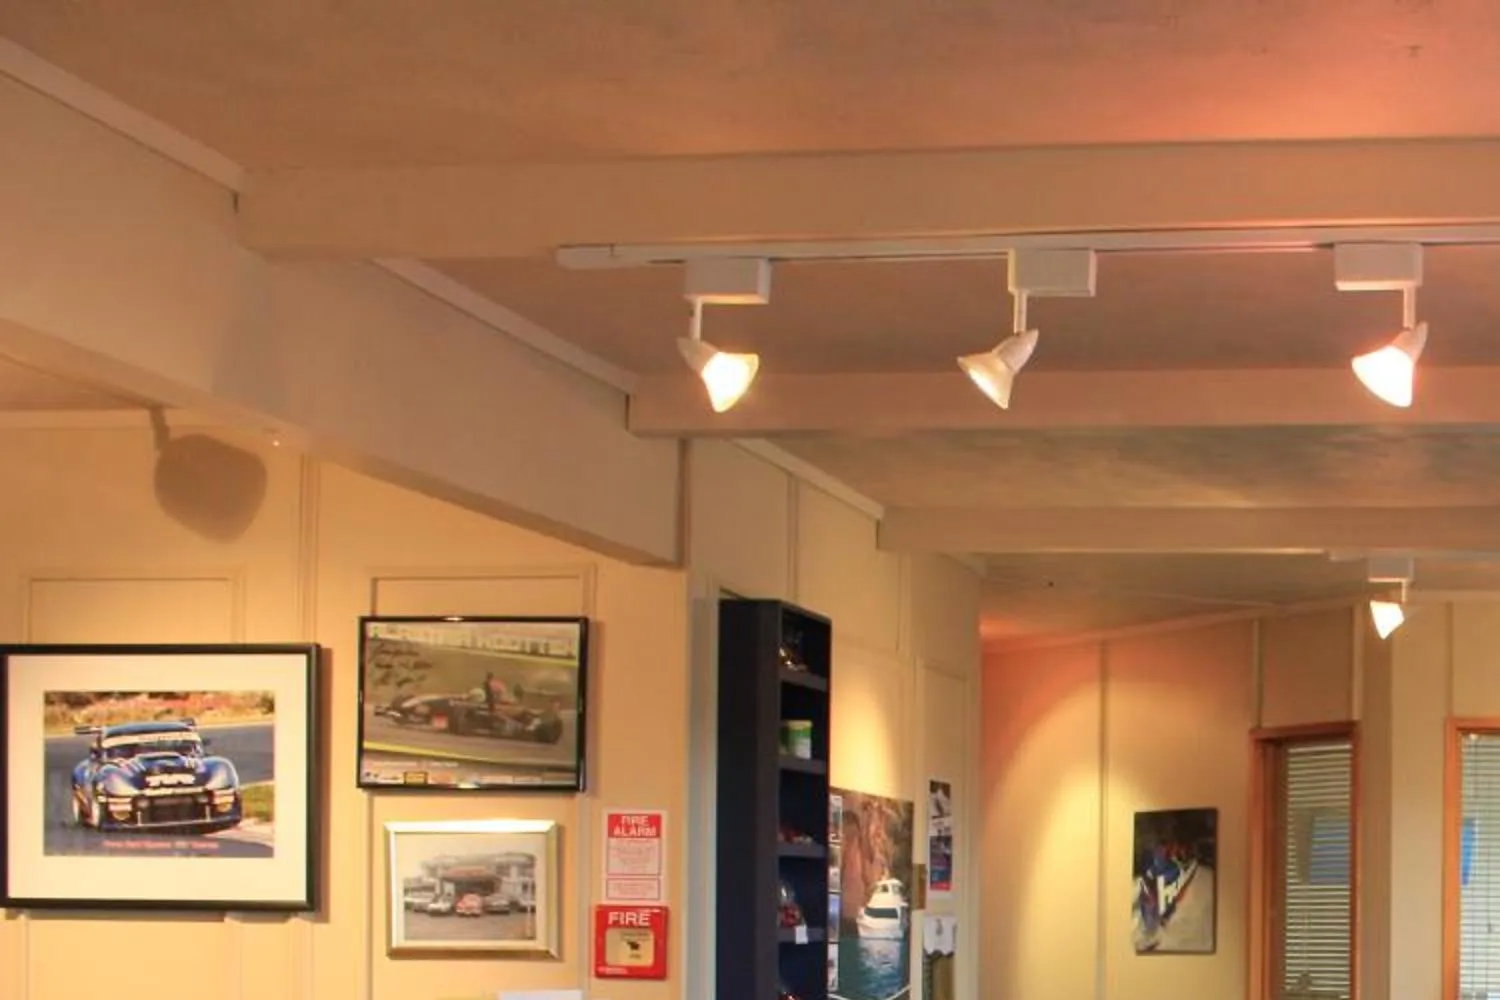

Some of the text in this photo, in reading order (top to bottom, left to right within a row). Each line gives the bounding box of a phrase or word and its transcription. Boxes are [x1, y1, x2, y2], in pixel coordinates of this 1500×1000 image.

[621, 815, 649, 826] FIRE
[613, 826, 656, 837] ALARM
[608, 911, 651, 927] FIRE
